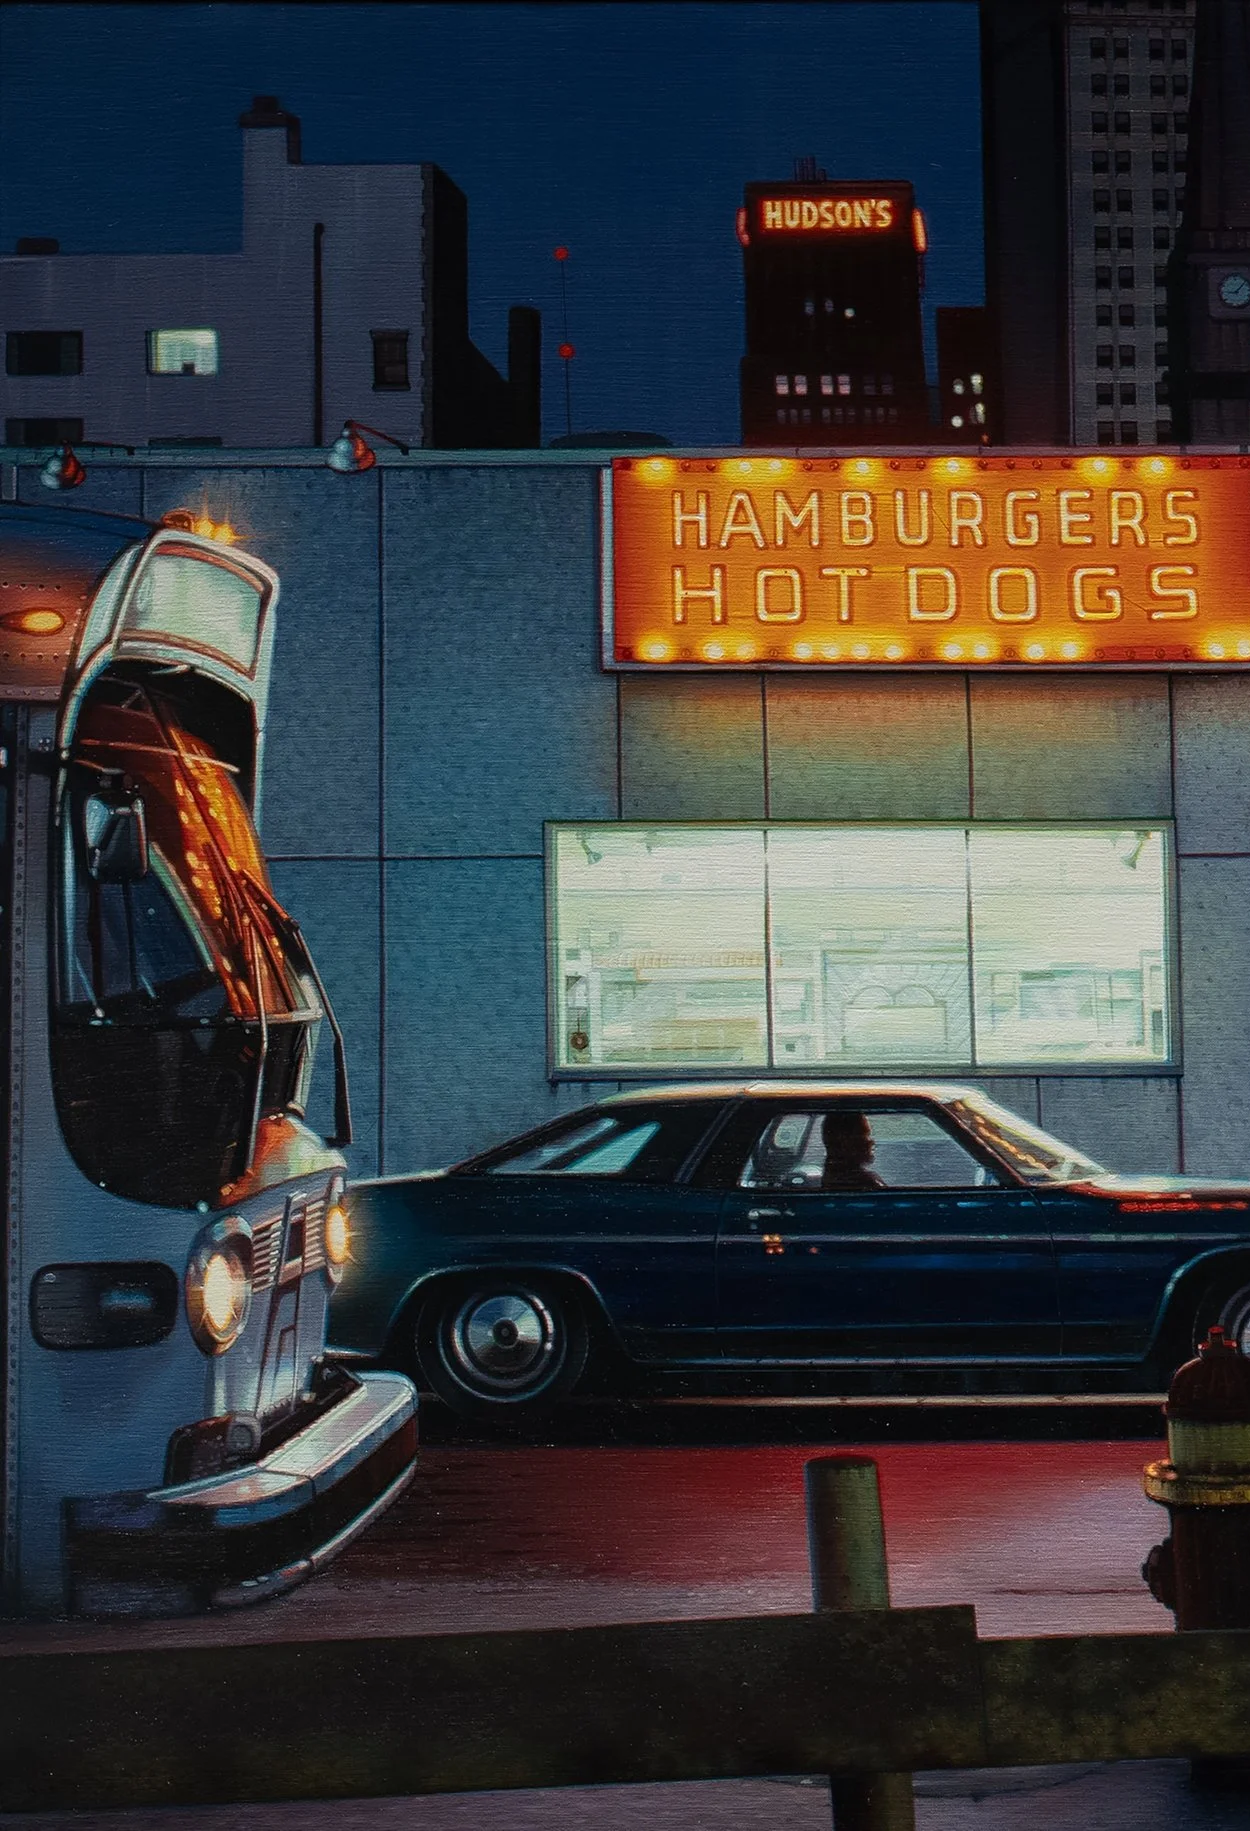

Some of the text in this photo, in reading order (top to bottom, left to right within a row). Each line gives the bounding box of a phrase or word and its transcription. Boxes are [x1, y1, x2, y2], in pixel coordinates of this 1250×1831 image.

[764, 199, 892, 229] HUDSON'S
[672, 490, 1198, 548] HAMBURGERS
[672, 565, 1199, 623] HOT DOGS
